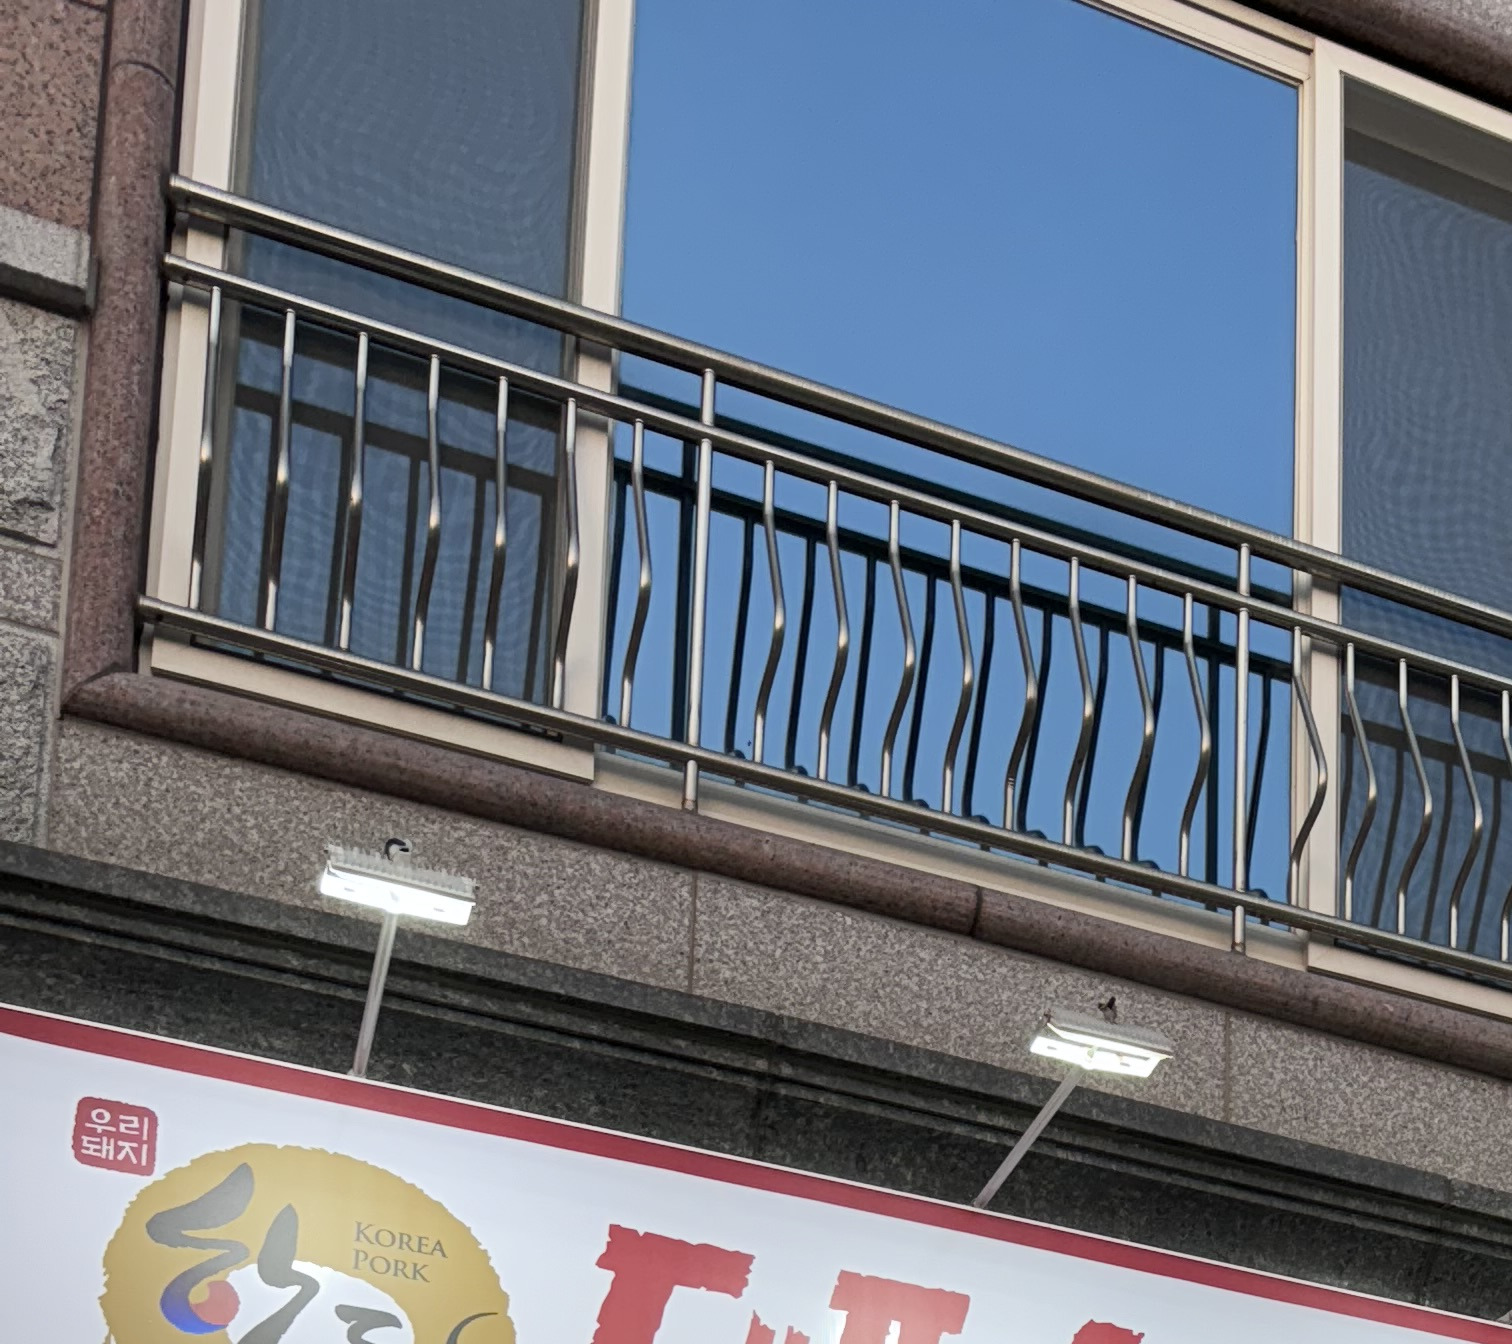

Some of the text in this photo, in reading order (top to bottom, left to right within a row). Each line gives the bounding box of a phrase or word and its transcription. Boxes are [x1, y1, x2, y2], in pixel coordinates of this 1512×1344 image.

[85, 1108, 149, 1140] 우리
[81, 1135, 148, 1166] 돼지
[354, 1220, 448, 1258] KOREA
[352, 1248, 430, 1283] PORK
